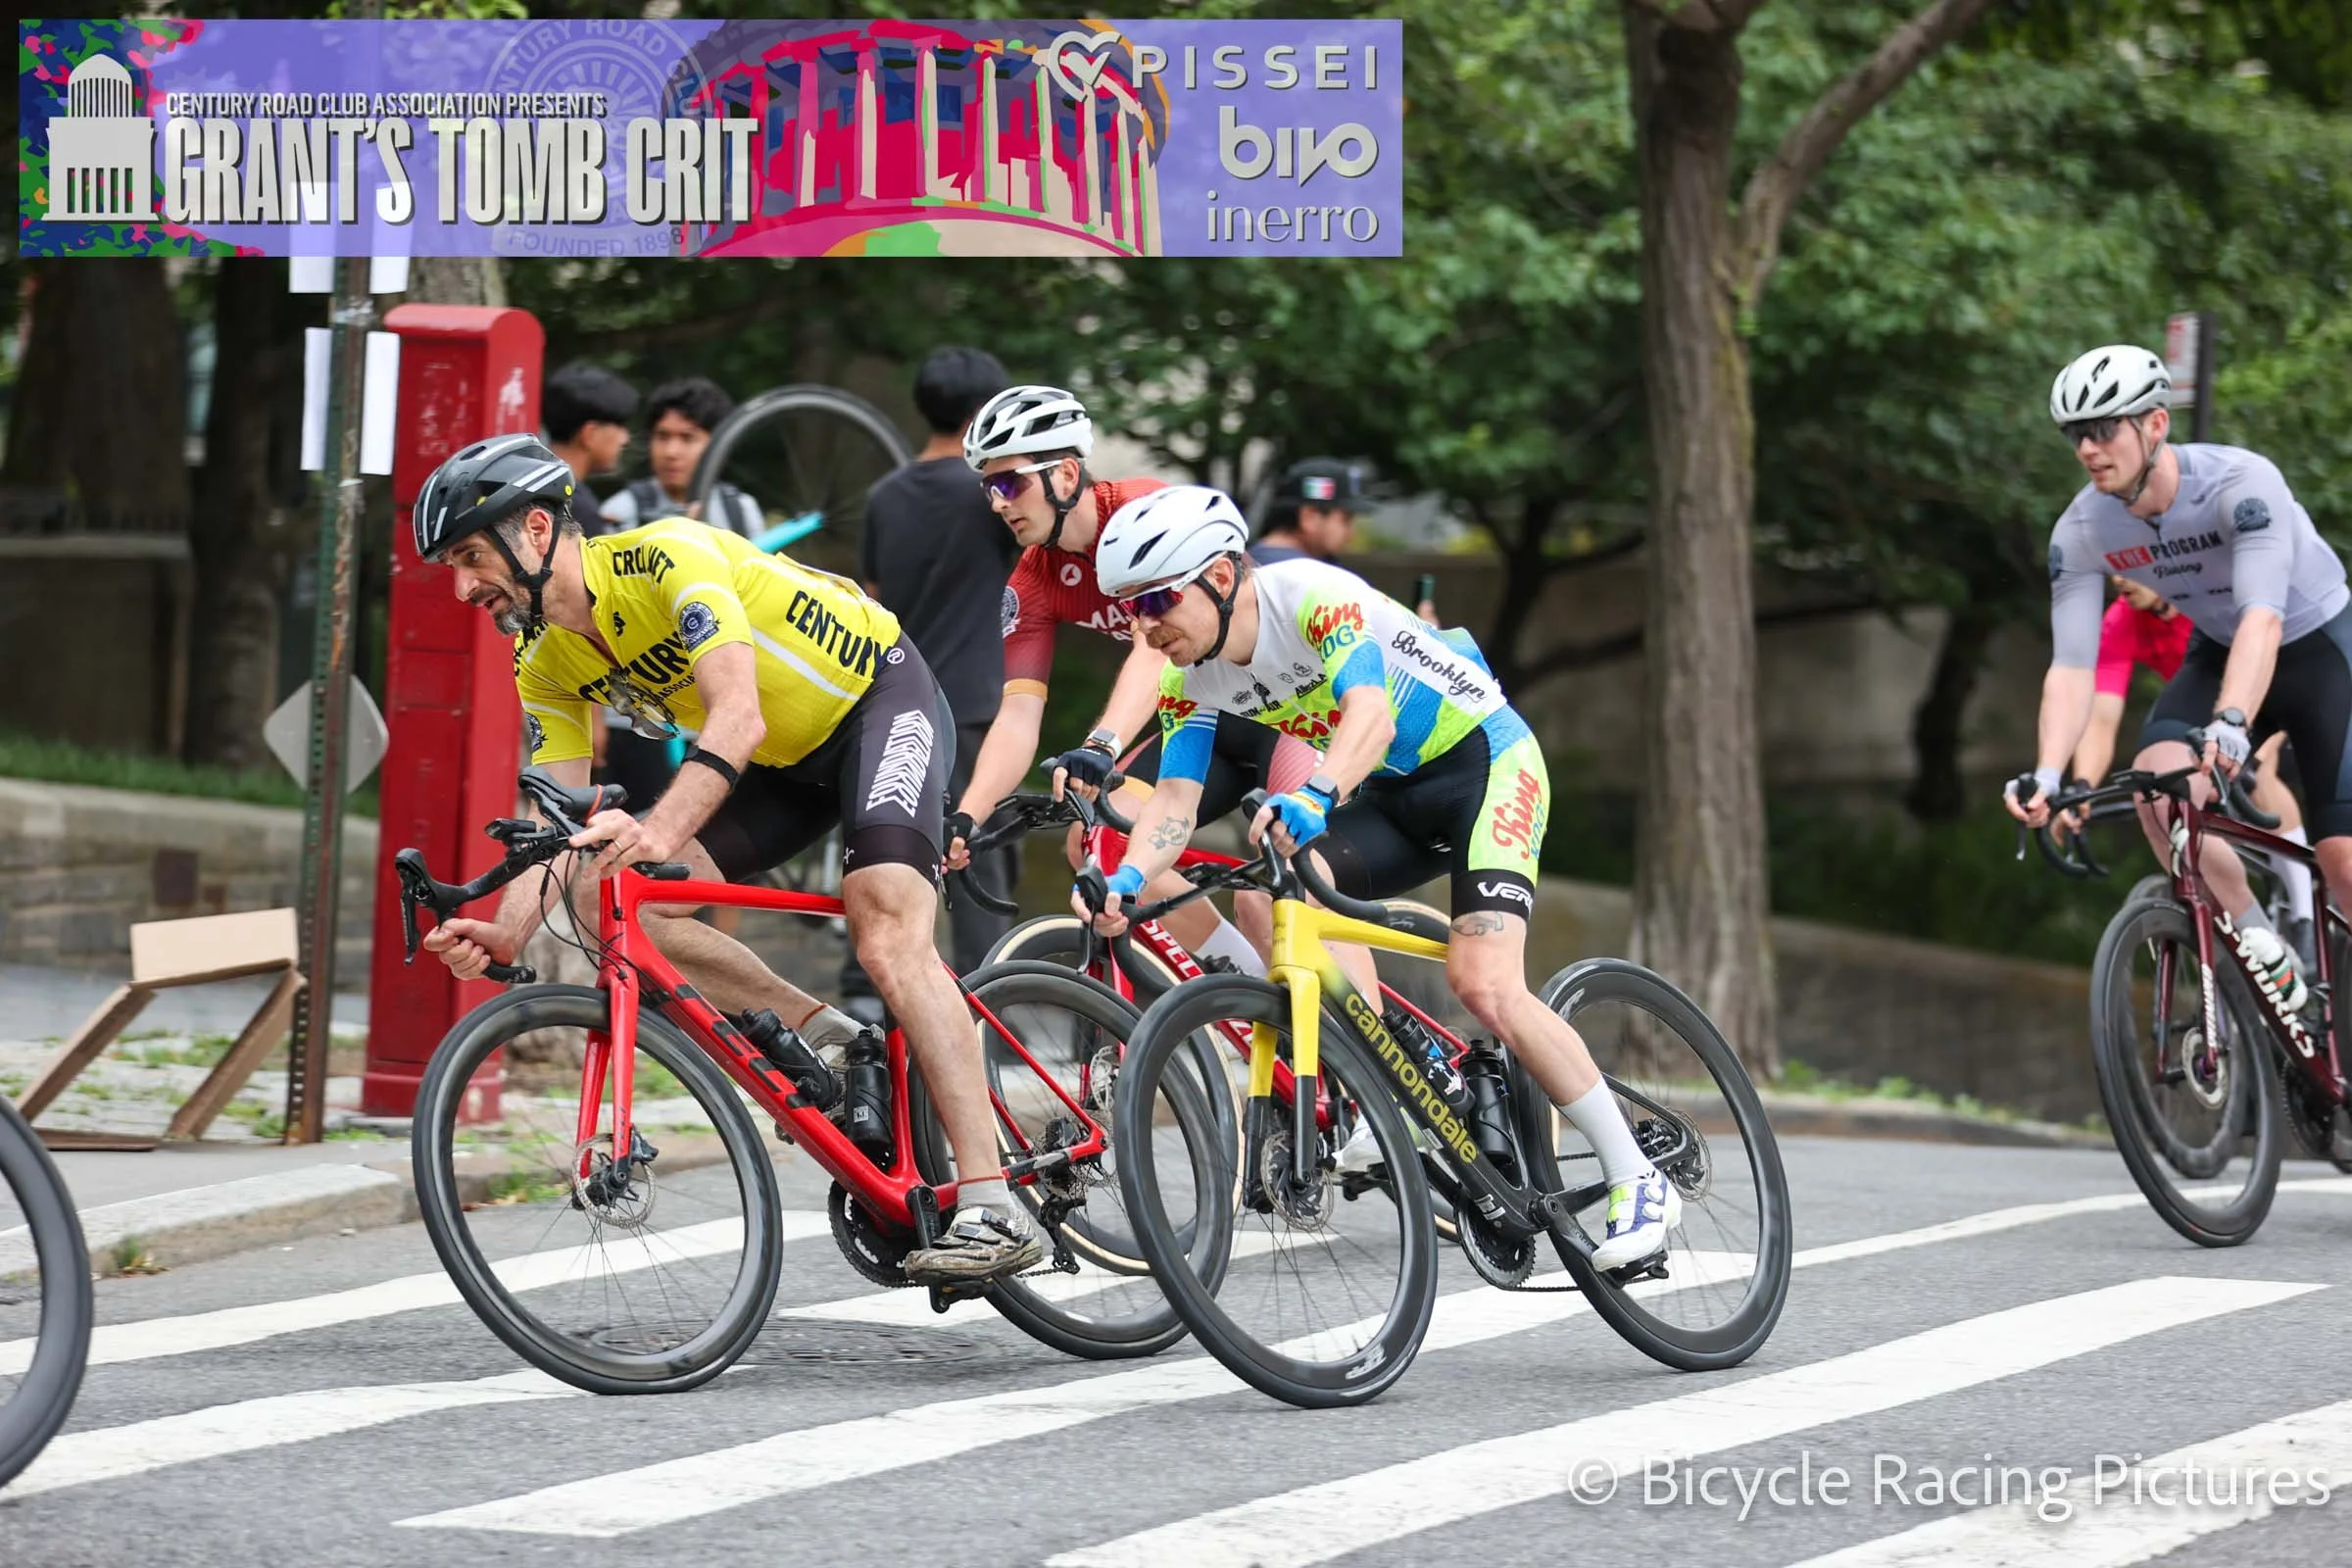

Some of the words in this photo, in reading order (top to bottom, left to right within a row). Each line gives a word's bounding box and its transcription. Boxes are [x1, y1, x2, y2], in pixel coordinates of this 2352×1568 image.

[2110, 548, 2149, 569] THE
[2149, 530, 2224, 560] PROGRAM
[579, 631, 690, 706] CEURY
[785, 590, 894, 678] CENTURY
[1392, 630, 1487, 704] Brooklyn
[656, 671, 696, 700] ASSOCIA
[1268, 710, 1342, 738] Kin
[1493, 768, 1542, 859] King
[1346, 994, 1478, 1163] cannondale
